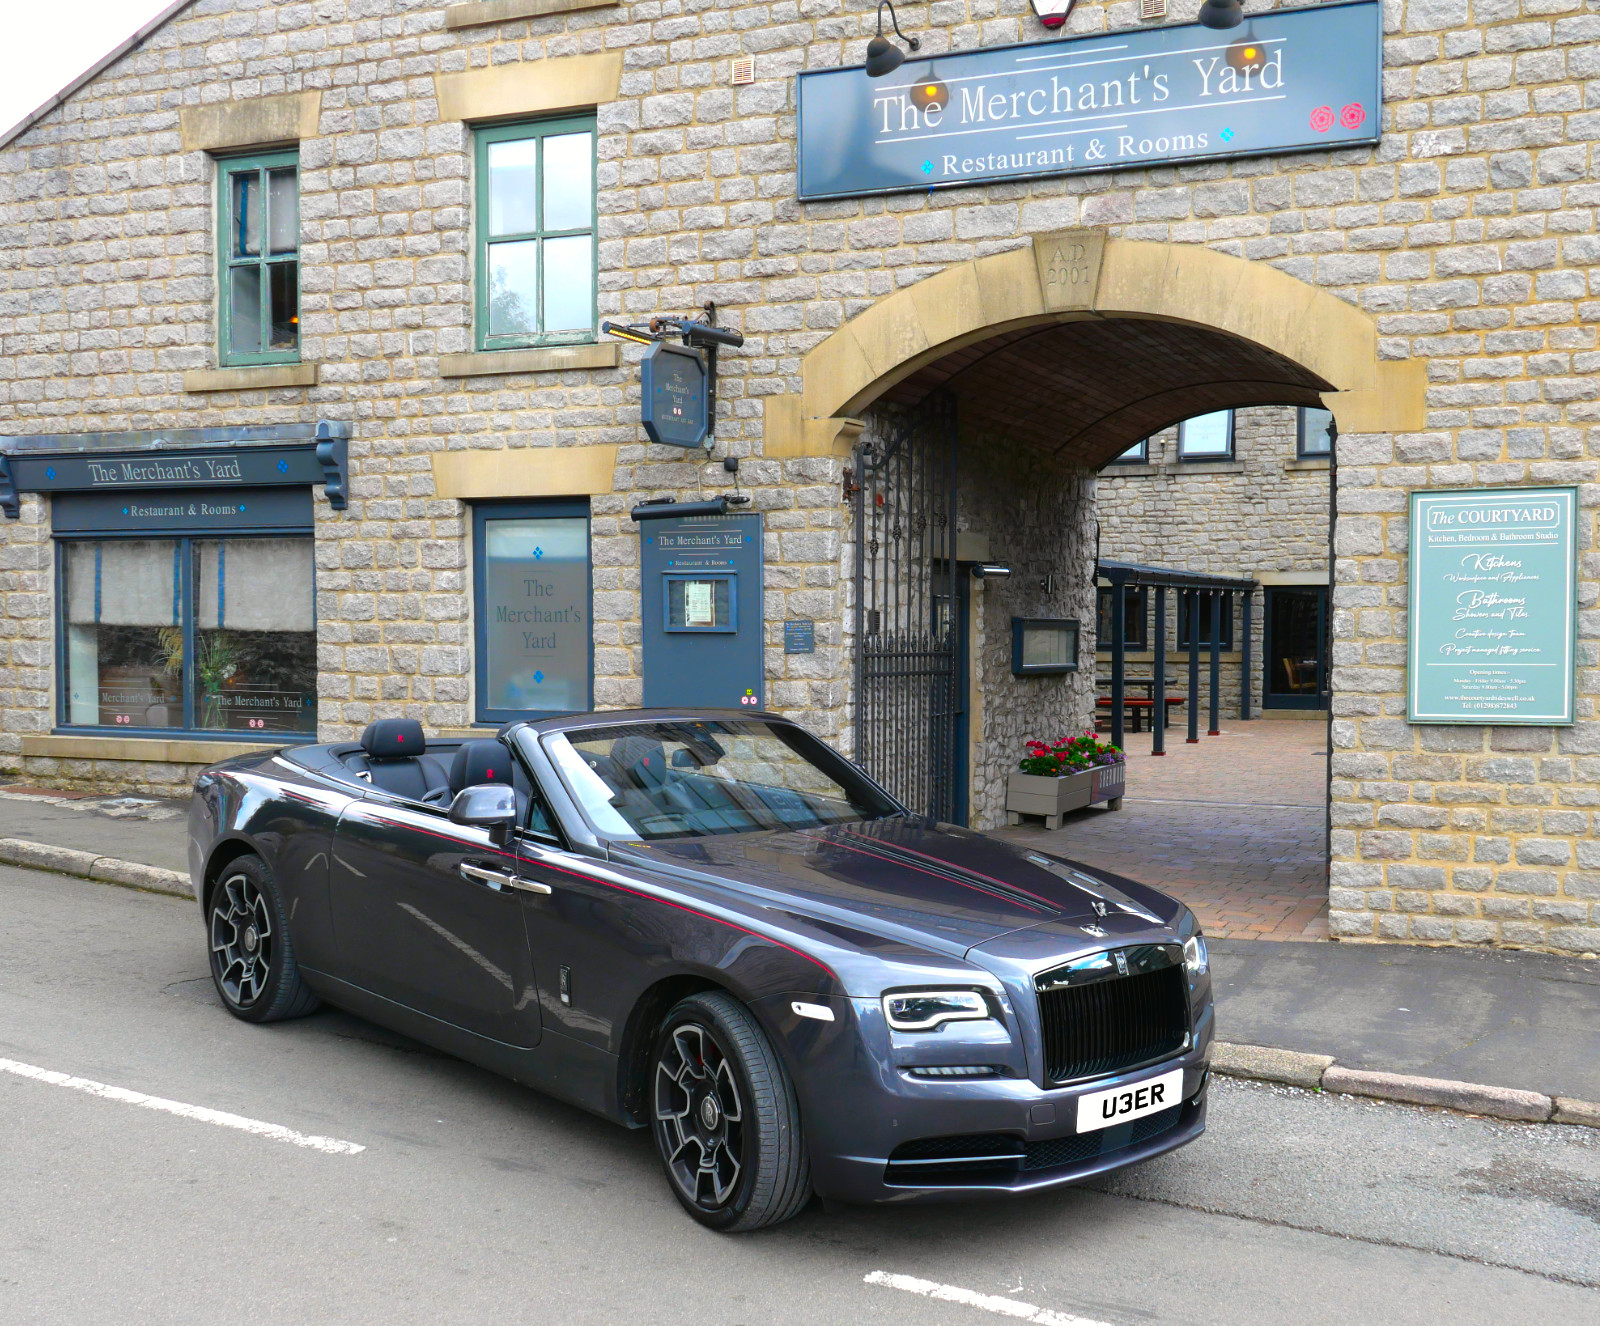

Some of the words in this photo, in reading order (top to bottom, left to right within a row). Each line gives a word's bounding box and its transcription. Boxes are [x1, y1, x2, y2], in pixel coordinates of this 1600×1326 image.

[873, 94, 943, 133] The
[960, 65, 1169, 124] Merchant's
[1192, 49, 1285, 97] Yard
[942, 143, 1075, 176] Restaurant
[1084, 138, 1107, 160] &
[1117, 132, 1209, 157] Rooms
[1047, 266, 1089, 286] 2001
[672, 373, 683, 383] The
[672, 394, 683, 404] Yard
[88, 463, 118, 482] The
[121, 460, 201, 481] Merchant's
[205, 459, 242, 479] Yard
[130, 504, 184, 517] Restaurant
[187, 503, 197, 516] &
[201, 502, 237, 515] Rooms
[1432, 511, 1455, 525] The
[1457, 507, 1555, 524] COURTYARD
[659, 535, 675, 546] The
[677, 534, 721, 545] Merchant's
[724, 534, 742, 545] Yard
[1428, 534, 1457, 543] Kitchen,
[1458, 533, 1490, 542] Bedroom
[1491, 532, 1498, 541] &
[1500, 531, 1534, 541] Bathroom
[1535, 531, 1559, 540] Studio
[1461, 553, 1522, 571] Kitchens
[523, 579, 554, 597] The
[1456, 589, 1526, 609] Bathrooms
[496, 605, 581, 623] Merchant's
[1452, 607, 1489, 621] Showers
[1490, 608, 1506, 620] and
[522, 632, 557, 649] Yard
[1455, 628, 1486, 639] Creative
[1487, 629, 1507, 639] design
[102, 693, 144, 703] Merchant's
[147, 693, 166, 703] Yard
[216, 695, 232, 706] The
[234, 695, 280, 707] Merchant's
[283, 696, 303, 708] Yard
[1102, 1083, 1165, 1119] U3ER
